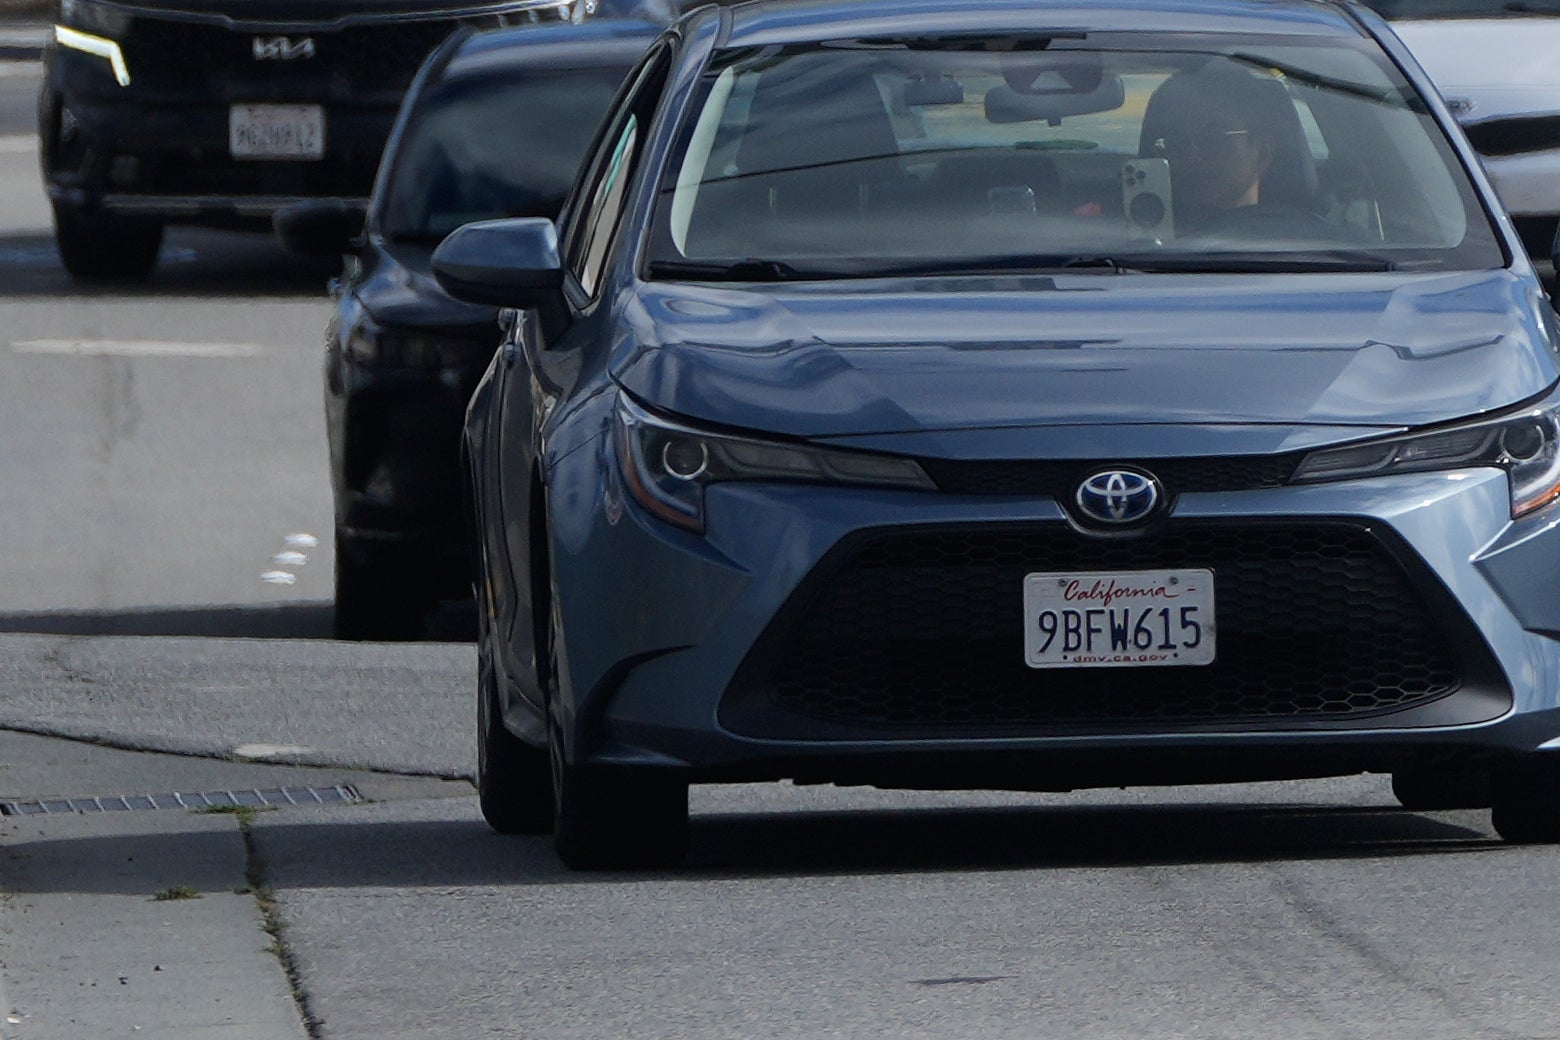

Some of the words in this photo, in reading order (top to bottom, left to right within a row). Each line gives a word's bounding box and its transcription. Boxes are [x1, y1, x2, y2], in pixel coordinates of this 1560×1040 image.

[1064, 578, 1179, 607] California
[1038, 606, 1201, 654] 9BFW615
[1073, 654, 1168, 664] dmv.ca.gov
